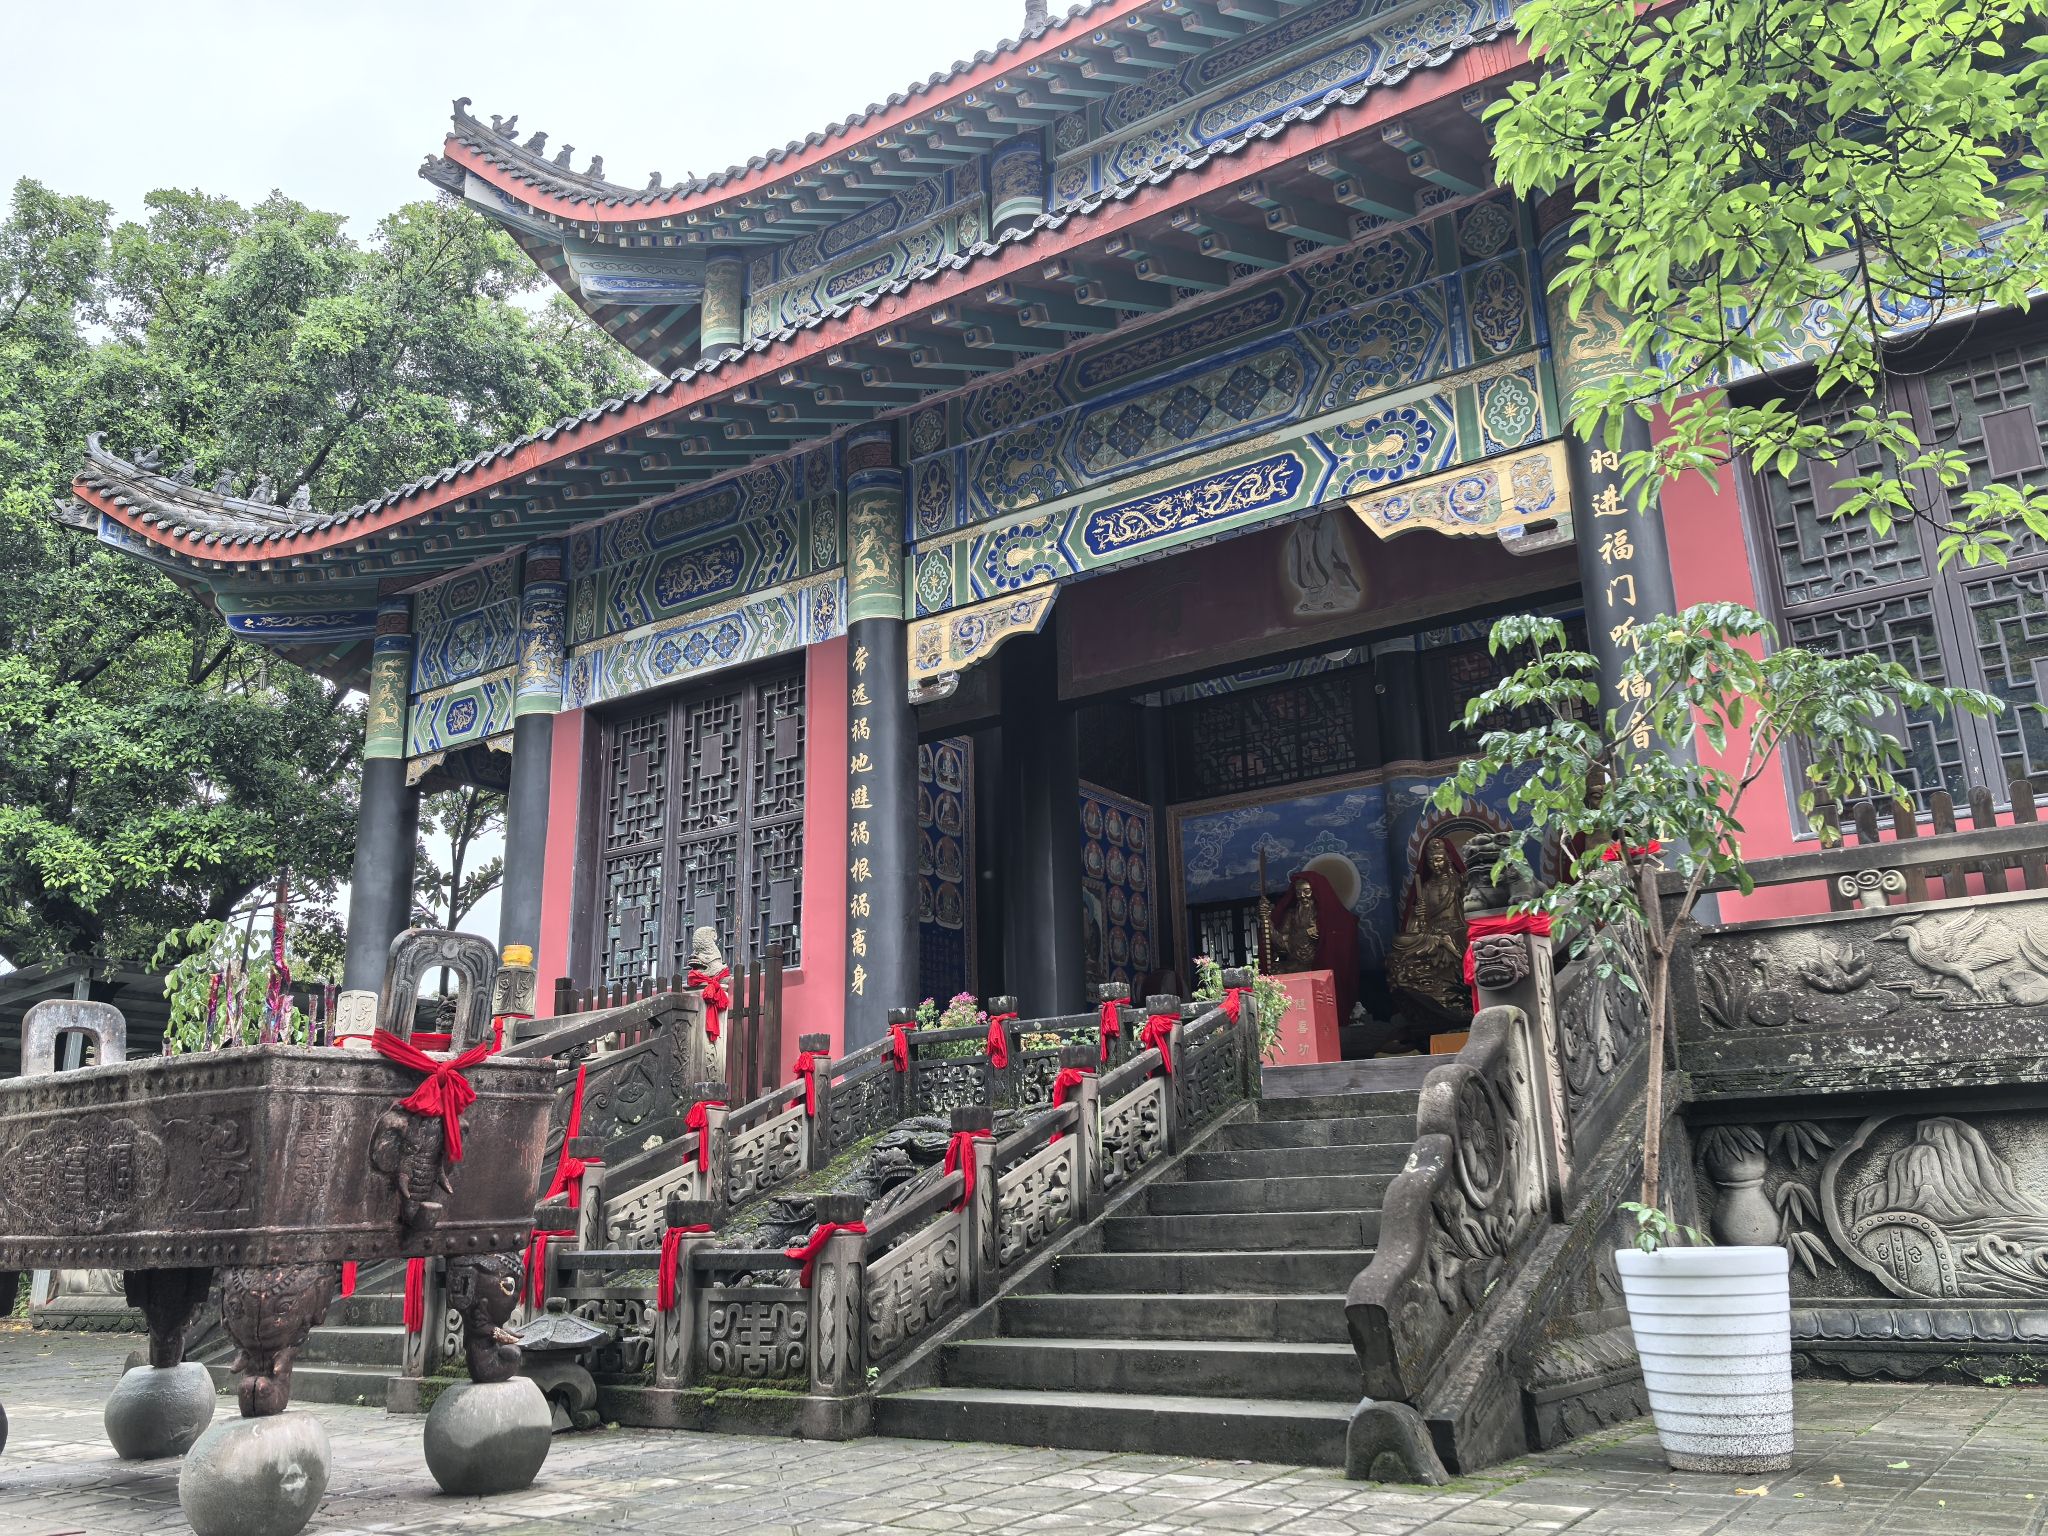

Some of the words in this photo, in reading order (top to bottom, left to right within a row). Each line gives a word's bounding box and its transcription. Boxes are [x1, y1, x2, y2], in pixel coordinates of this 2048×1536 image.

[850, 646, 873, 996] 常远祸地避祸根祸离身
[1589, 448, 1676, 872] 时进福门听福音
